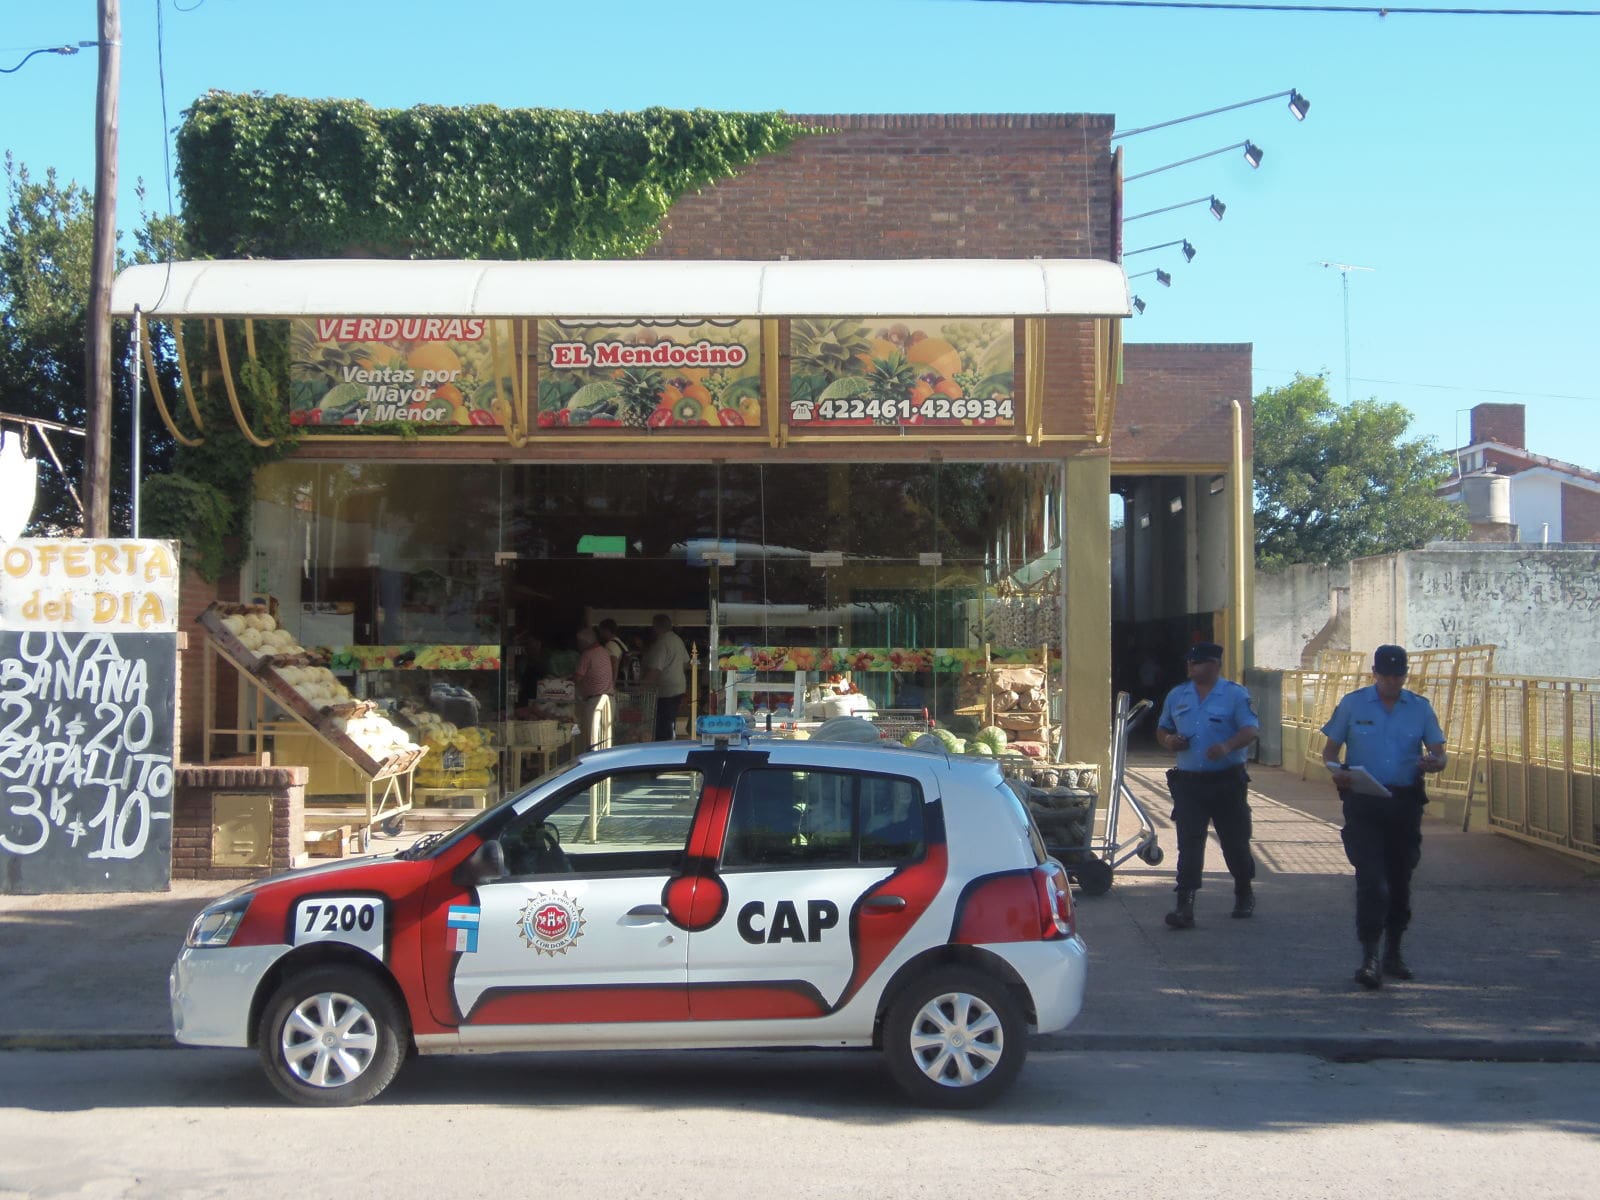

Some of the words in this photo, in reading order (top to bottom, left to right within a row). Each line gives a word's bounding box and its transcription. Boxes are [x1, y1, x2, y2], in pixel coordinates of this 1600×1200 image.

[318, 318, 484, 341] VERDURAS
[554, 345, 588, 364] EL
[596, 344, 743, 364] Mendocino
[343, 366, 415, 383] Ventas
[421, 369, 460, 387] por
[366, 385, 436, 405] Mayor
[355, 408, 369, 424] y
[375, 406, 448, 422] Menor
[4, 545, 173, 582] OFERTA
[22, 590, 73, 622] del
[92, 590, 166, 630] DIA
[20, 631, 124, 665] UVA
[0, 658, 148, 704] BANANA
[303, 904, 375, 932] 7200
[736, 899, 839, 945] CAP
